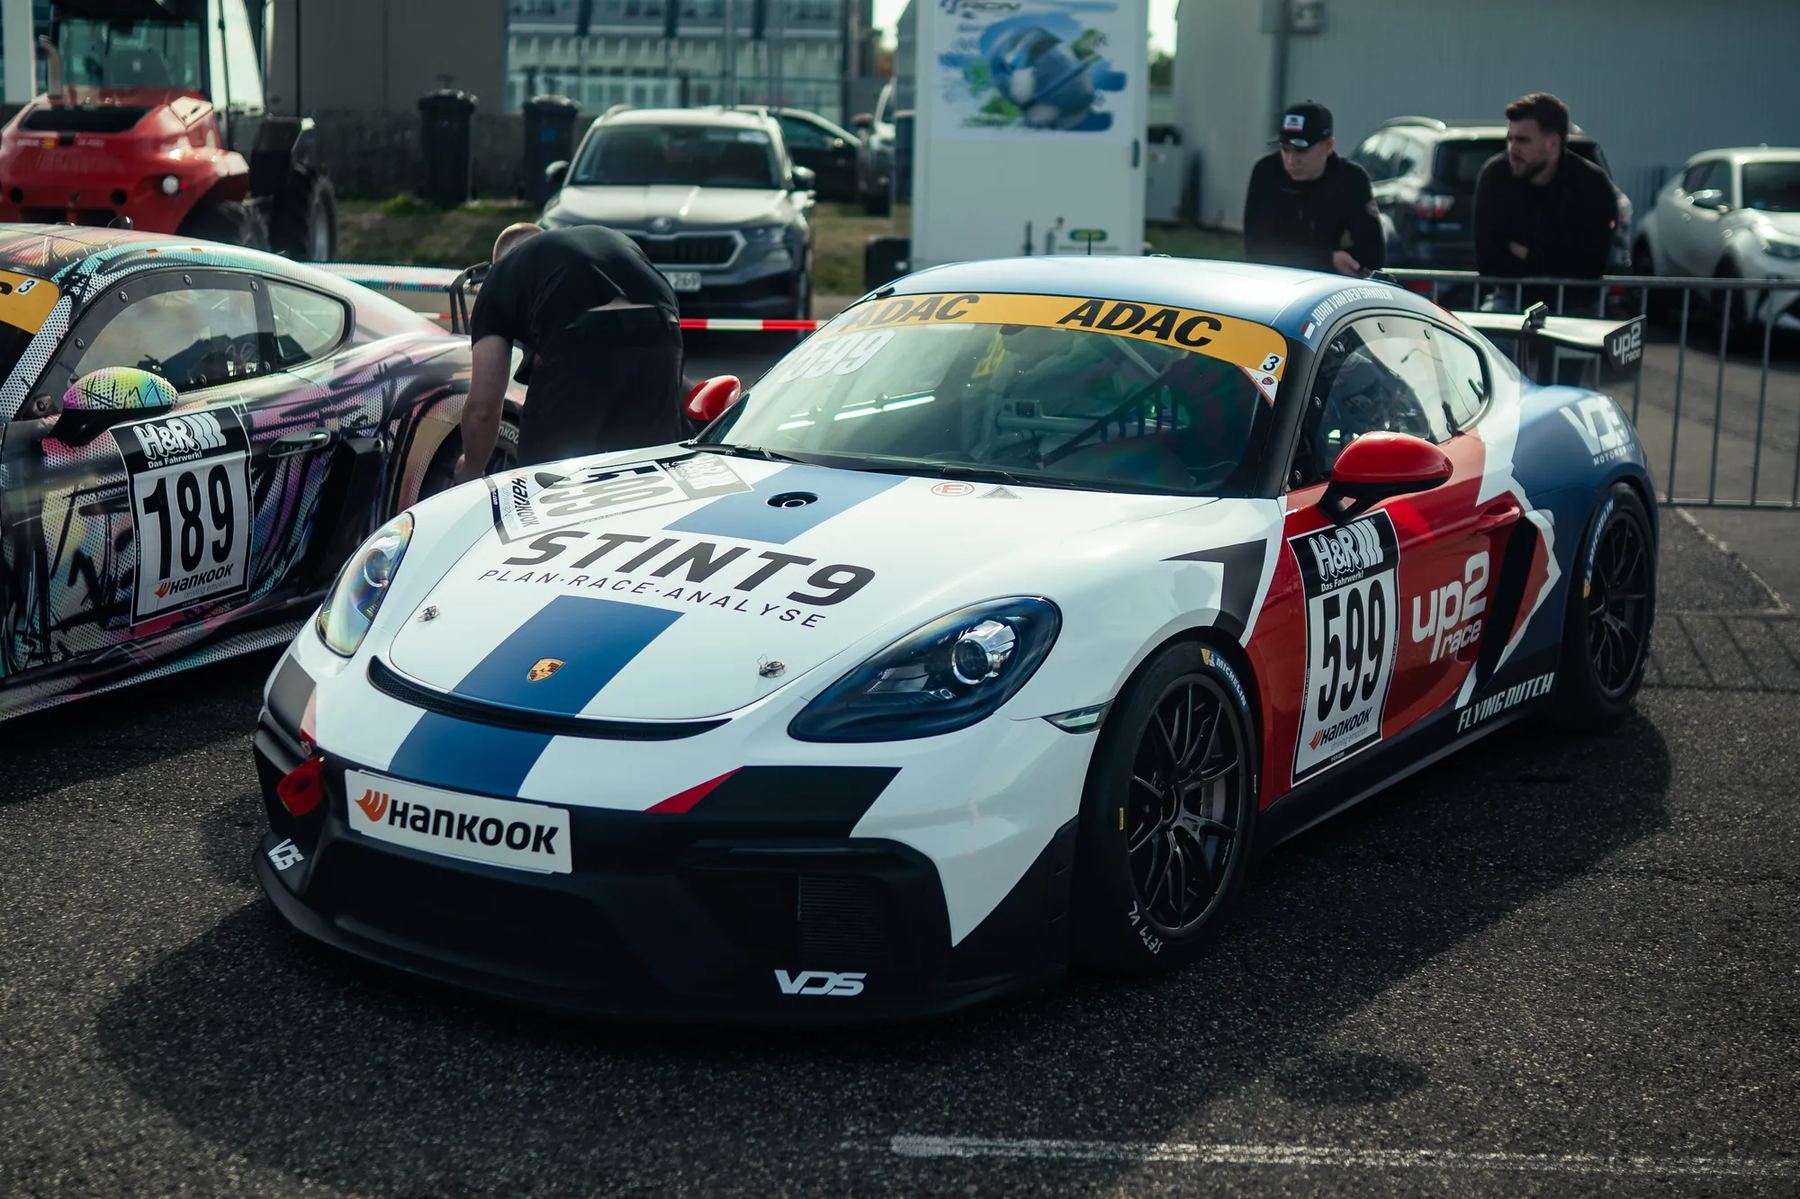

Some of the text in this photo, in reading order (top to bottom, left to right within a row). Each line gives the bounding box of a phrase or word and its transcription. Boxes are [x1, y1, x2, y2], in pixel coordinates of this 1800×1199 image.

[18, 280, 36, 293] 3
[828, 294, 980, 333] ADAC
[1056, 299, 1222, 347] ADAC
[1262, 355, 1279, 371] 3
[1613, 320, 1642, 365] up2
[147, 459, 162, 469] Das
[142, 463, 235, 581] 189
[502, 531, 876, 607] STINT9
[1321, 581, 1333, 593] Das
[1412, 550, 1490, 664] up2
[1318, 580, 1385, 722] 599
[1440, 619, 1482, 659] race
[1216, 657, 1246, 707] MICHELIN
[1456, 671, 1555, 734] FLYING DUTCH
[267, 838, 304, 871] VDS
[774, 969, 867, 996] VDS
